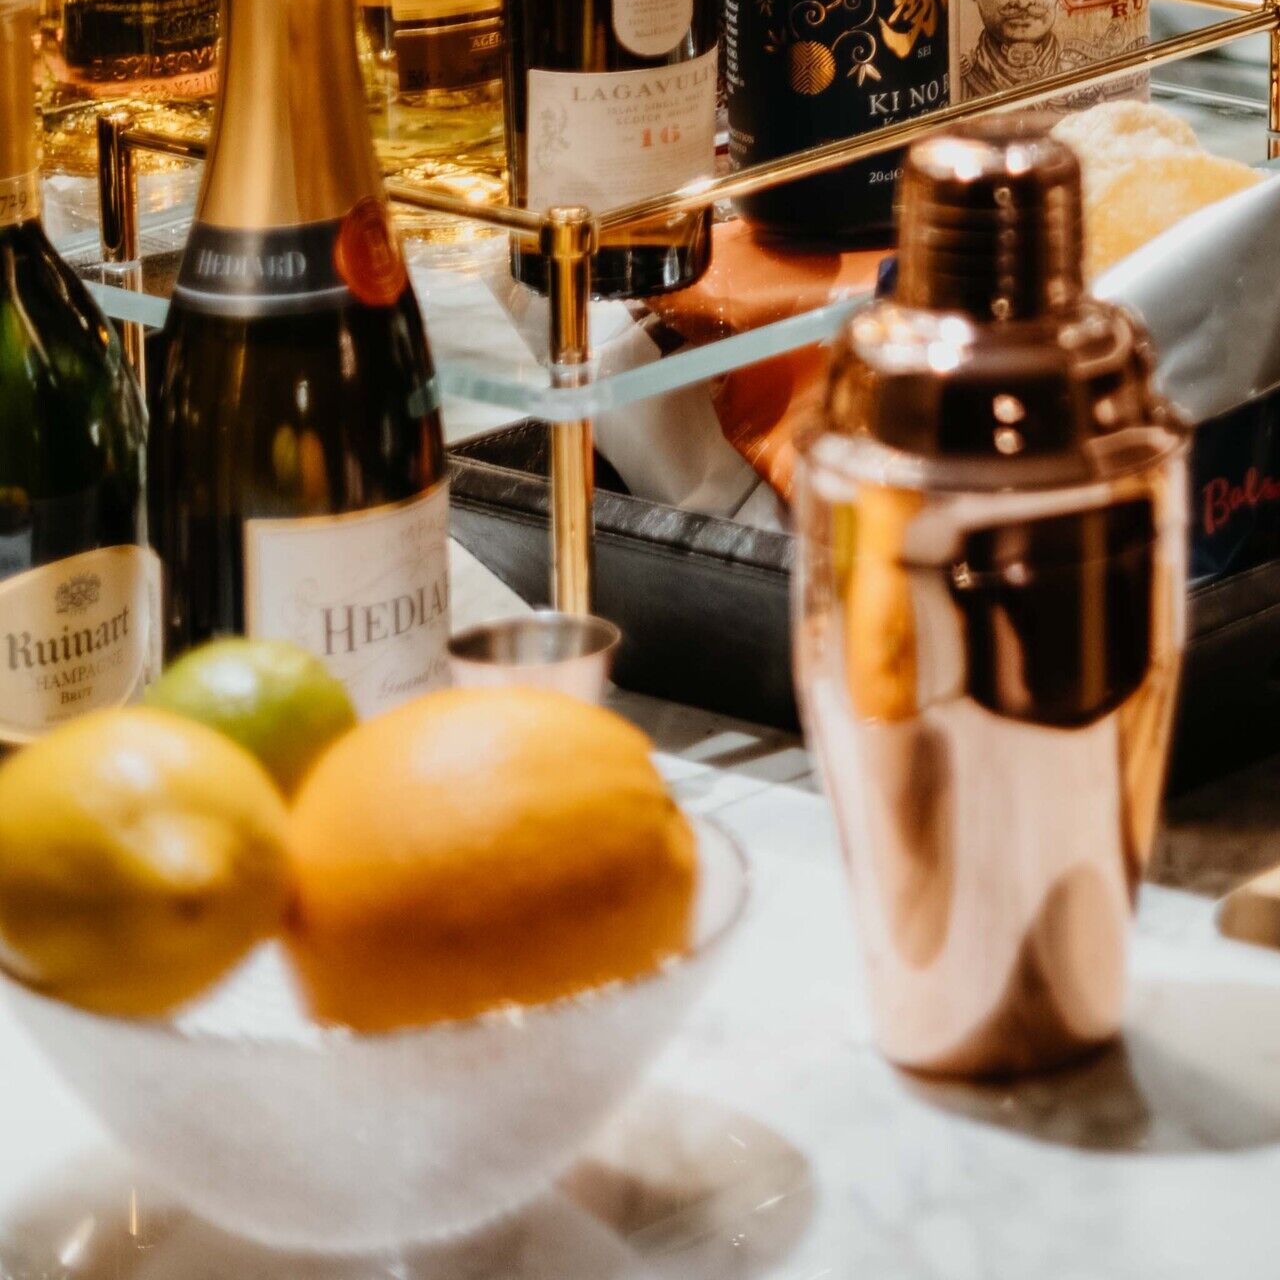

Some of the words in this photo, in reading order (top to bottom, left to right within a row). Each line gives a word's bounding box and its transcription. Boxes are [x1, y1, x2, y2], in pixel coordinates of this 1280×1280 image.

[917, 46, 931, 59] SEI
[868, 89, 901, 116] KI
[909, 79, 940, 109] NO
[641, 125, 682, 148] 16
[5, 606, 130, 671] Ruinart
